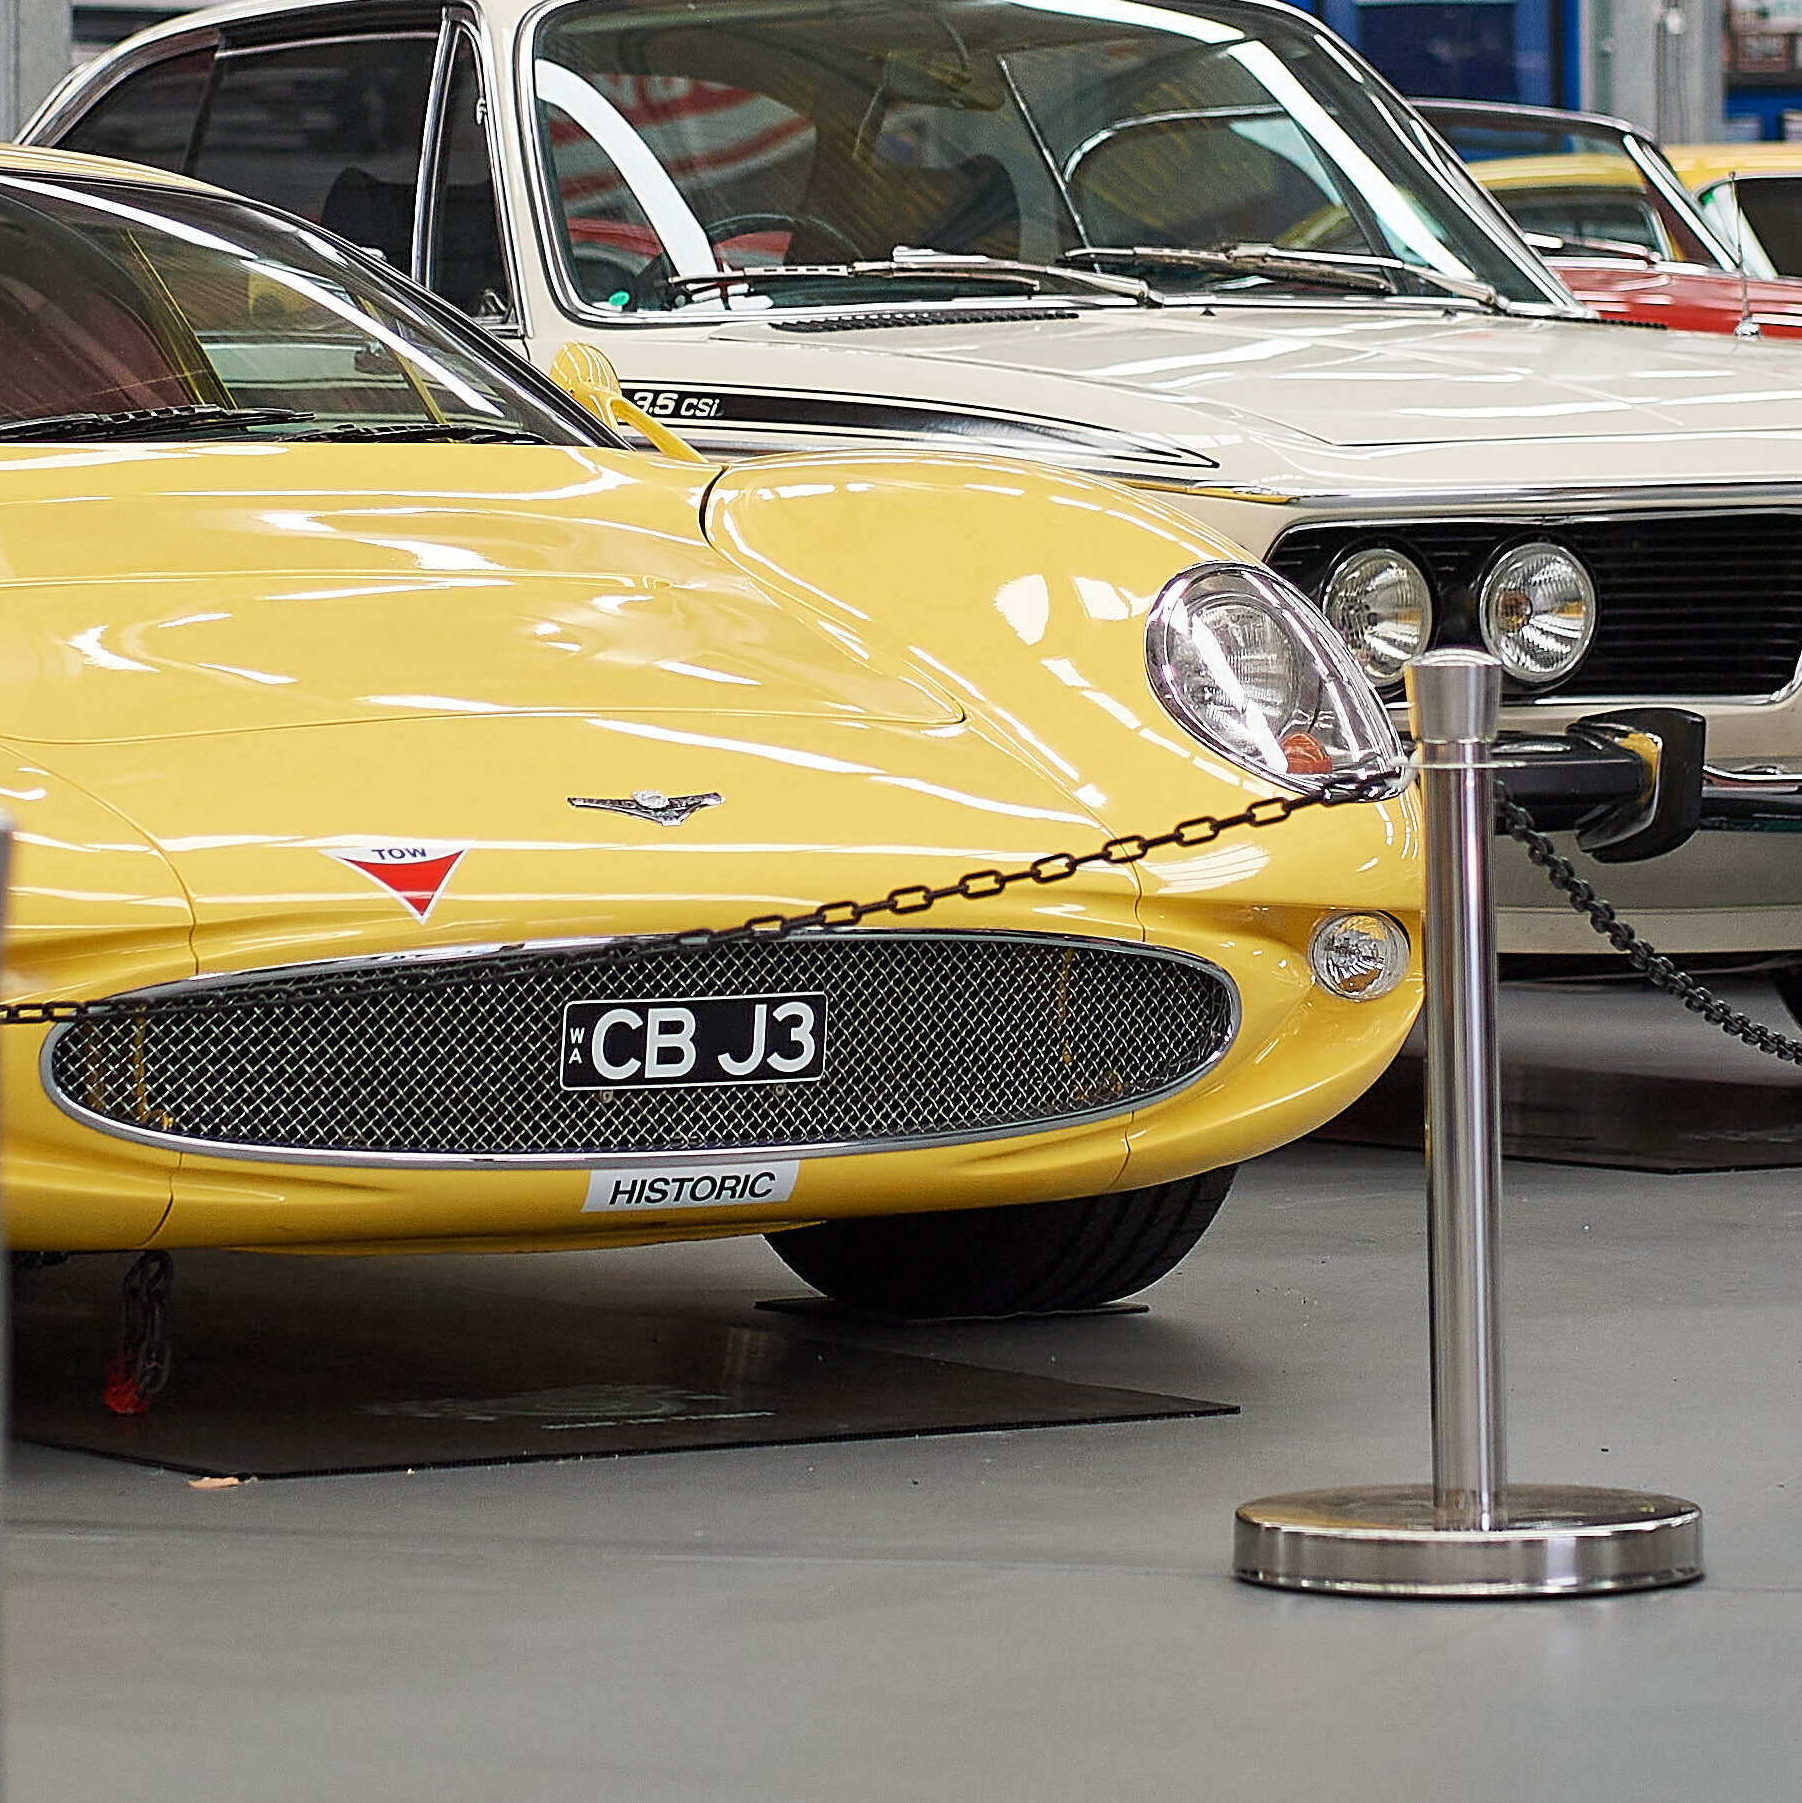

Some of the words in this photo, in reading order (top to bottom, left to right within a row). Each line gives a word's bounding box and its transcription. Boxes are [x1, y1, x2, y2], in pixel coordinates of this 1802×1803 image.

[370, 846, 428, 861] TOW
[592, 1008, 698, 1081] CB
[717, 1001, 816, 1078] J3
[608, 1171, 777, 1205] HISTORIC
